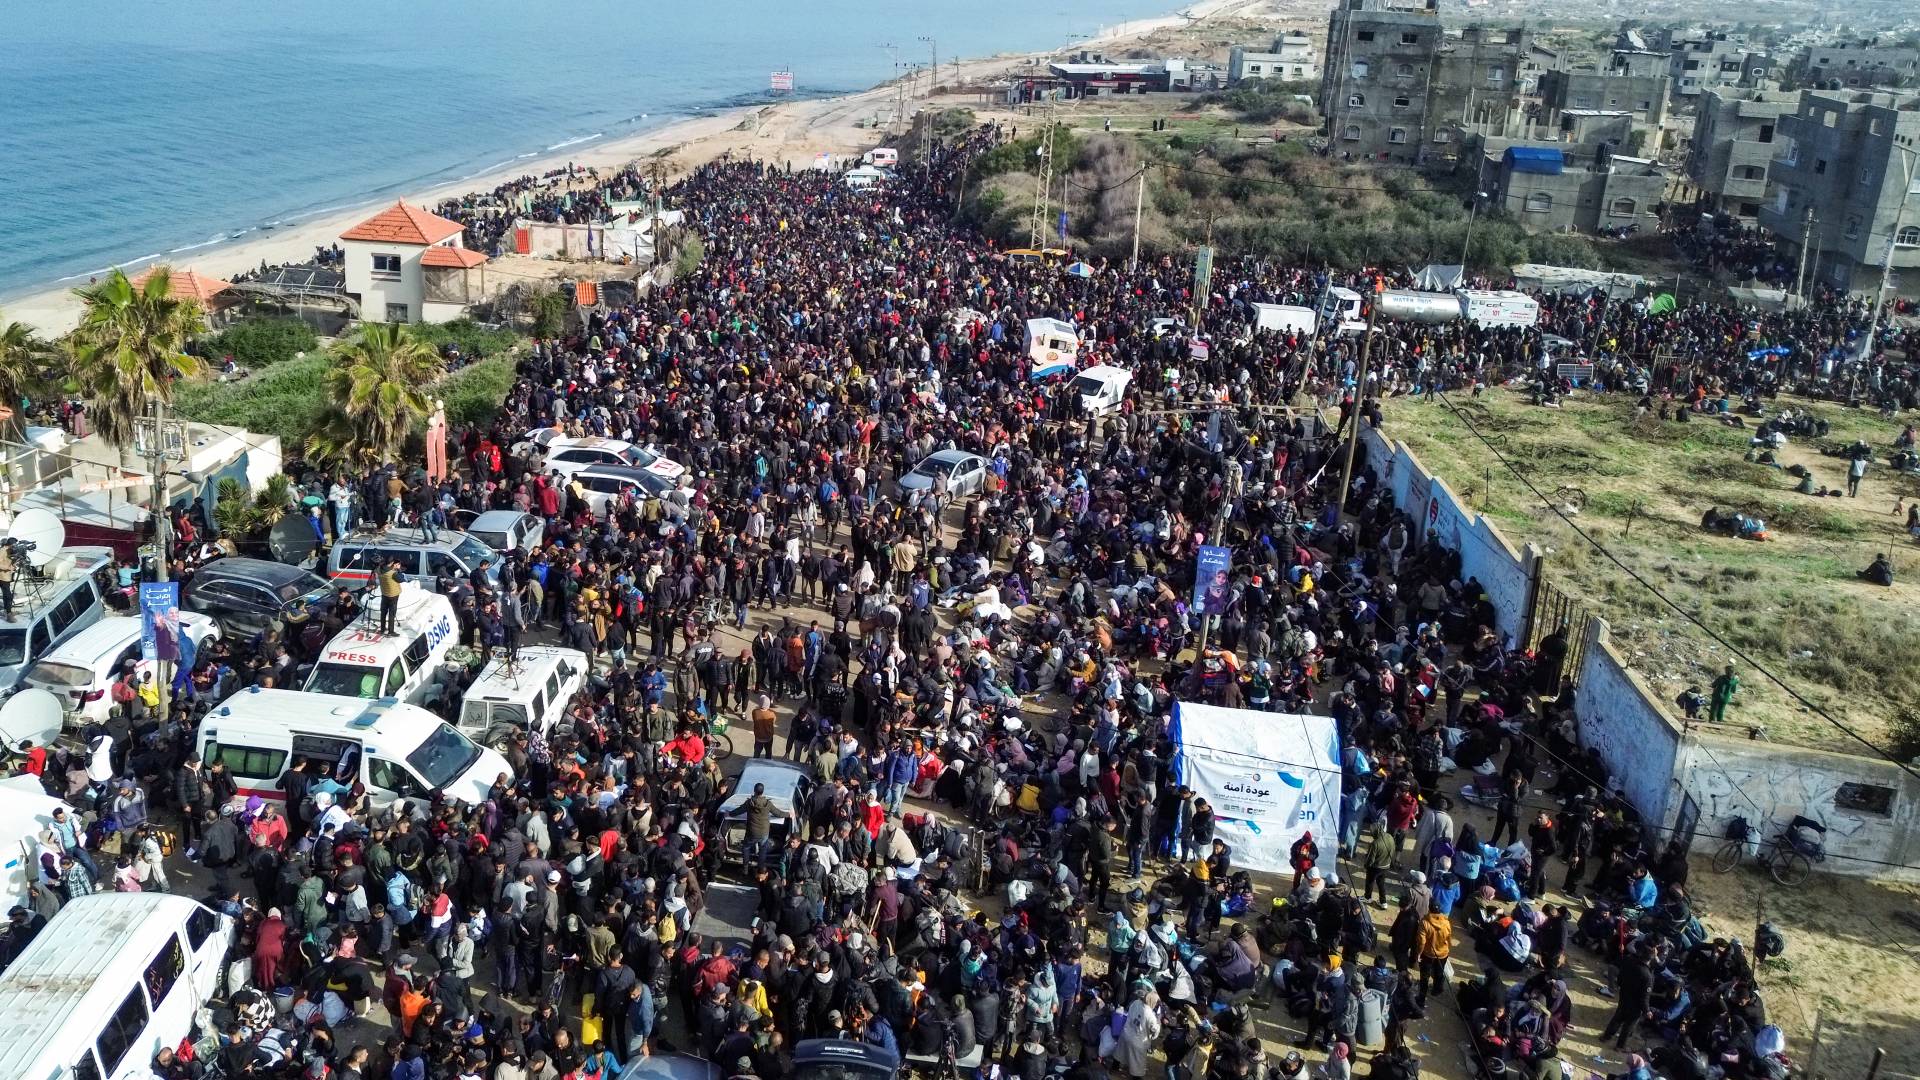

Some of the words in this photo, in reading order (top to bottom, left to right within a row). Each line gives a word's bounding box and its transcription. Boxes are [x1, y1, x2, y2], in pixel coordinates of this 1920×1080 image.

[427, 614, 451, 650] DSNG
[328, 651, 377, 664] PRESS
[1223, 781, 1244, 793] آمنة
[1245, 785, 1271, 797] عودة
